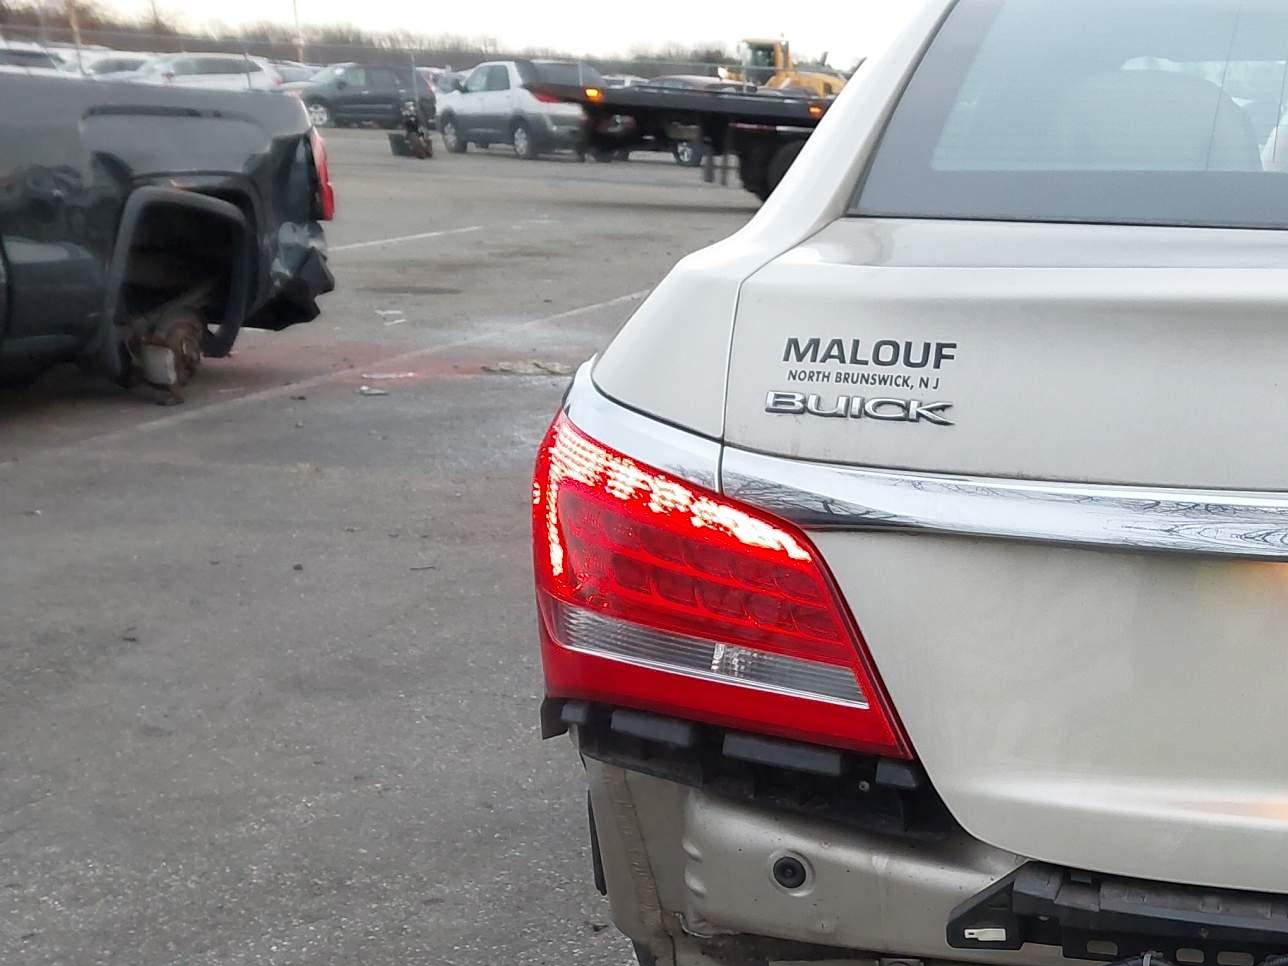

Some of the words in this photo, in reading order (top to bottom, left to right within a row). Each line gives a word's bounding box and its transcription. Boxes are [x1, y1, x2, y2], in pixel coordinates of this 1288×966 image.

[783, 338, 957, 369] MALOUF
[787, 369, 831, 383] NORTH
[835, 371, 914, 390] BRUNSWICK,
[764, 390, 956, 427] BUICK
